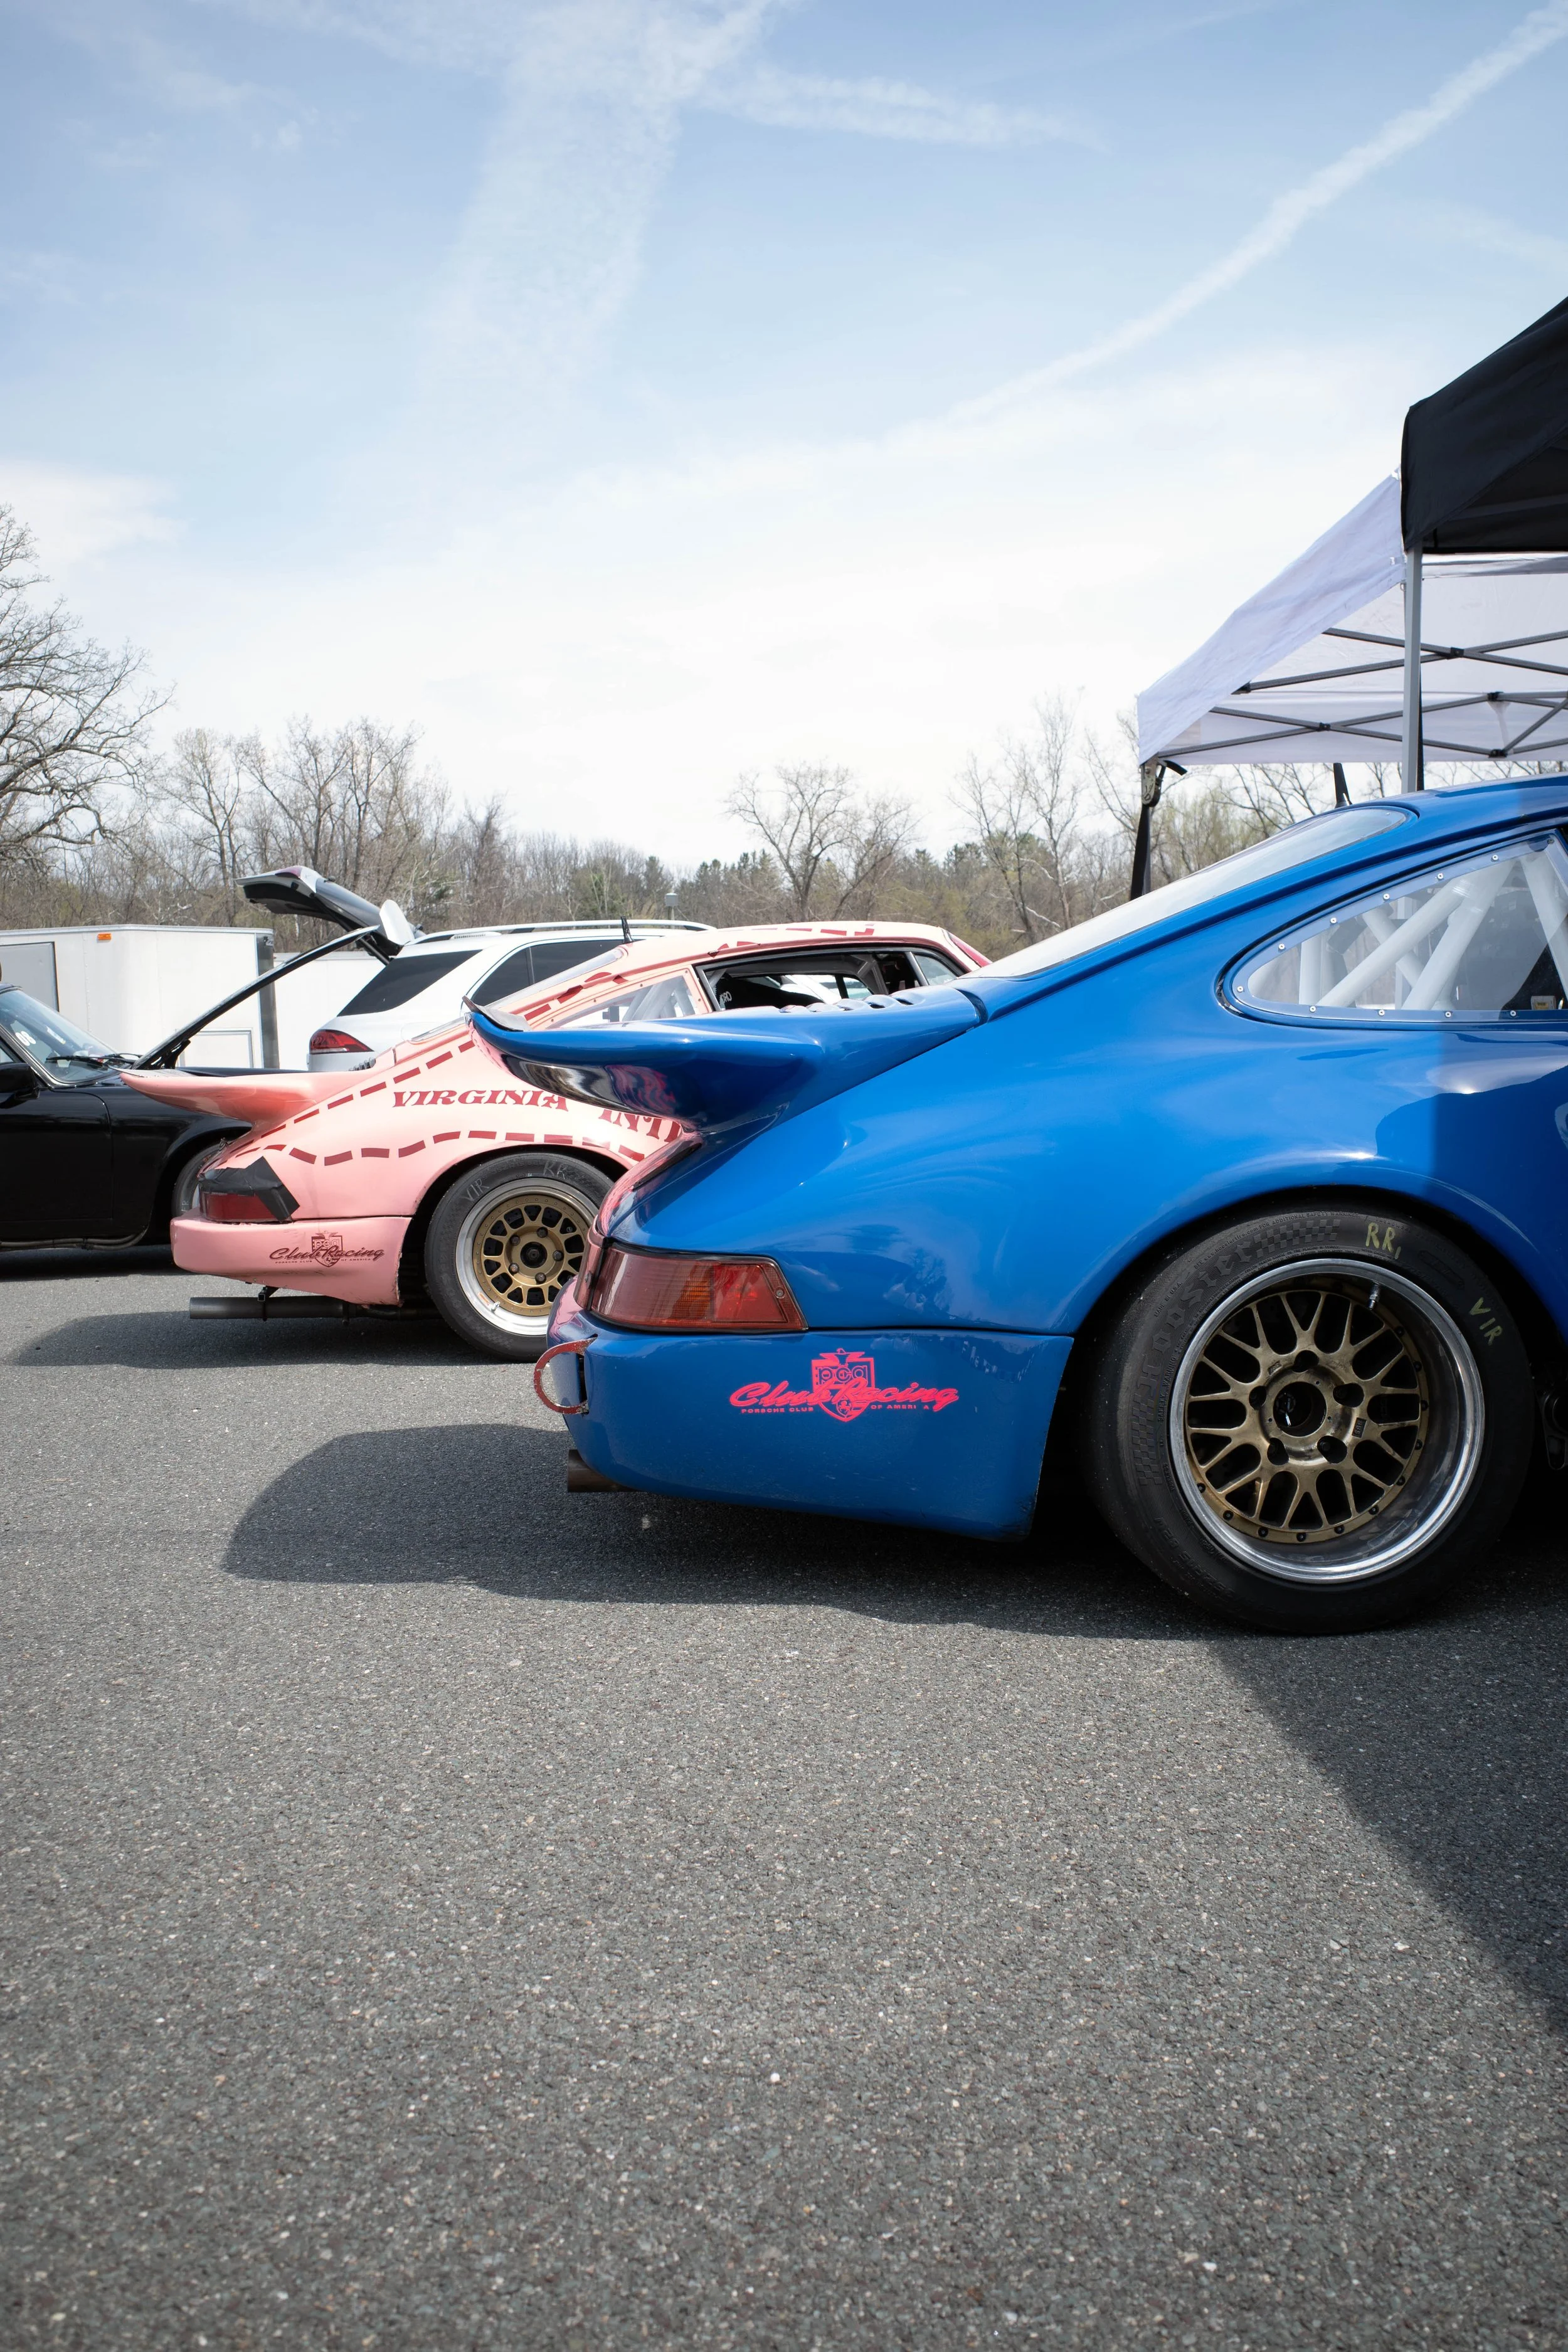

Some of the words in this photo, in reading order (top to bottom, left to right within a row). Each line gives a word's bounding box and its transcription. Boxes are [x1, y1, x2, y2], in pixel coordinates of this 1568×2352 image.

[392, 1089, 569, 1111] VIRGINIA
[460, 1179, 490, 1202] VIR
[269, 1247, 321, 1260] Club
[321, 1245, 384, 1261] Racing
[1469, 1297, 1503, 1346] VIR
[729, 1380, 833, 1407] Club
[831, 1377, 960, 1412] Racing
